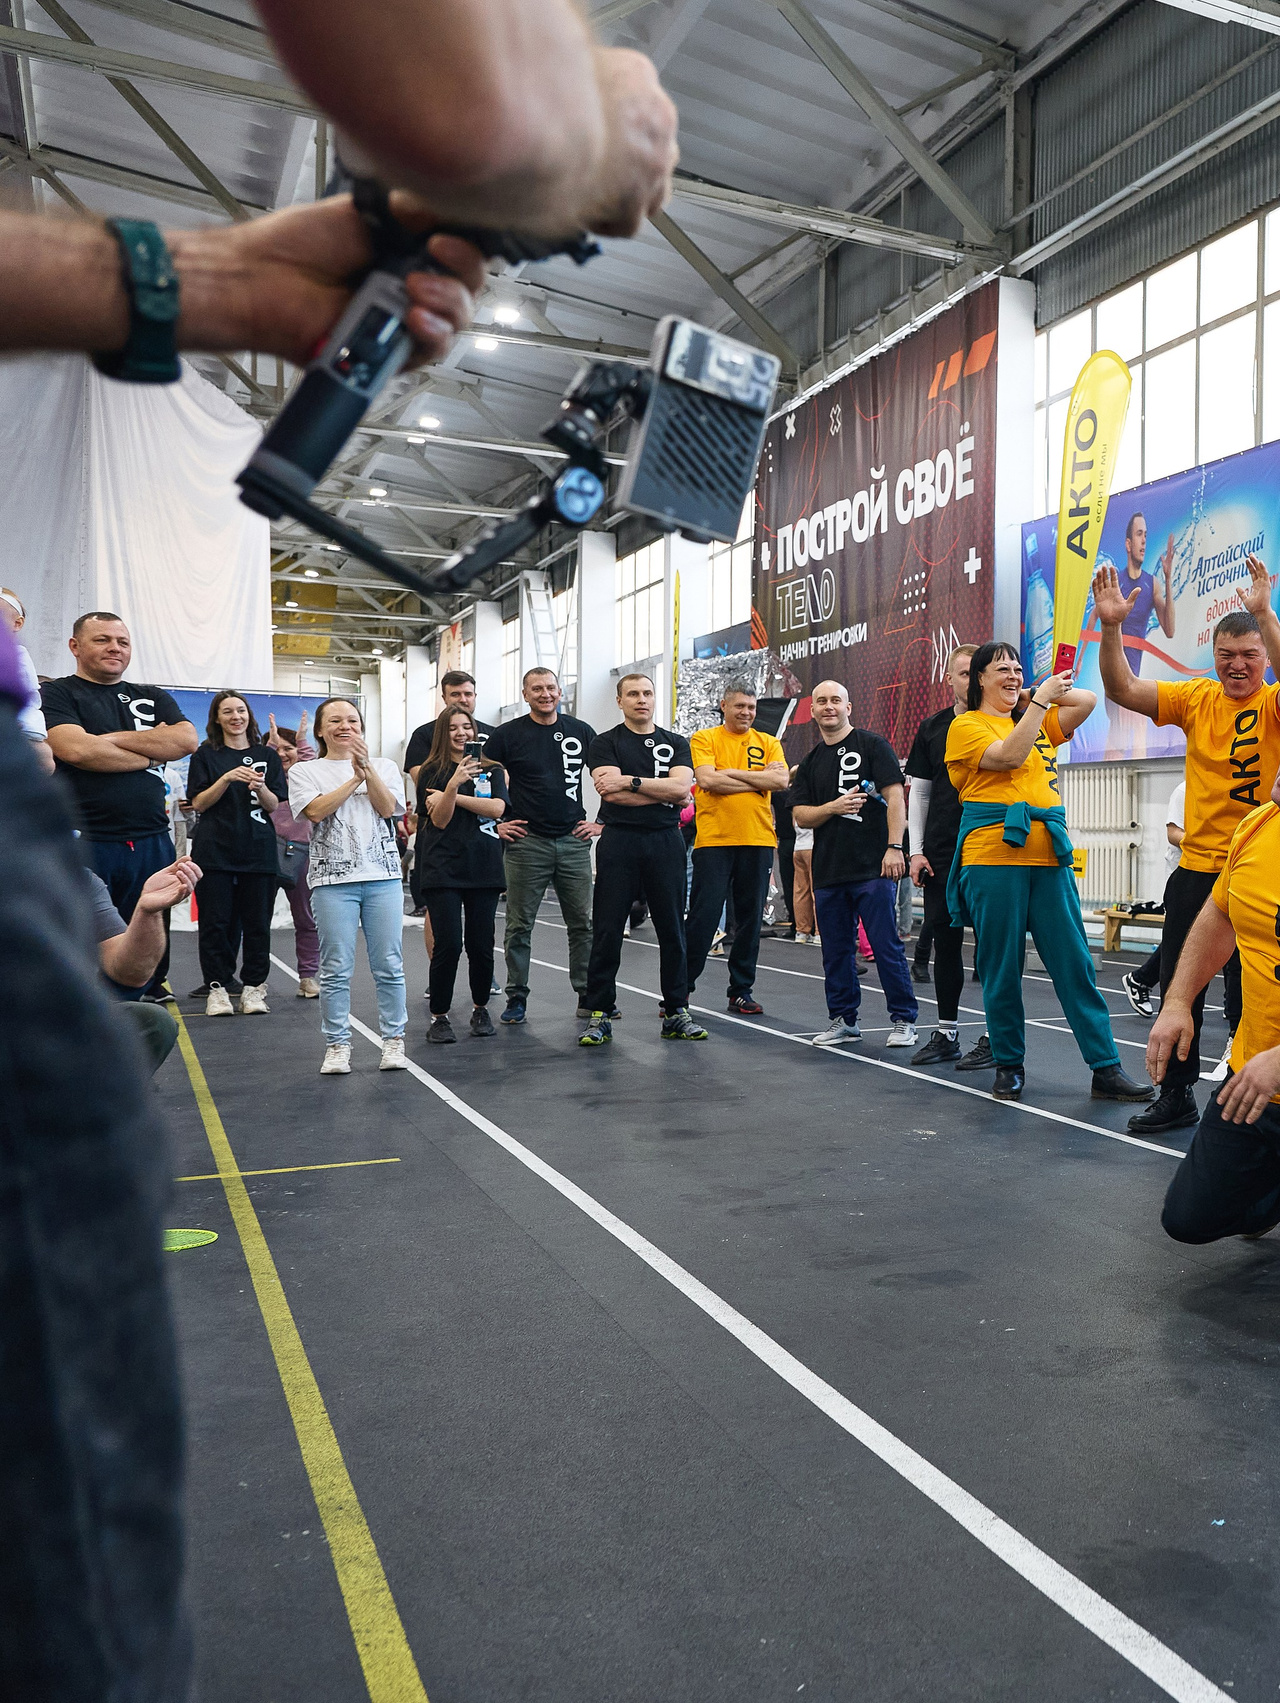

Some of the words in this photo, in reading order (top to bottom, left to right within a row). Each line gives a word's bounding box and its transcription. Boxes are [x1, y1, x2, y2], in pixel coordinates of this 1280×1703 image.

[777, 464, 888, 575] ПОСТРОЙ
[895, 421, 975, 525] СВОЁ
[1191, 530, 1264, 583] Алтайский
[1197, 562, 1251, 597] источни
[776, 568, 836, 632] ТЕЛО
[561, 737, 582, 802] АКТО
[1229, 709, 1260, 806] АКТО
